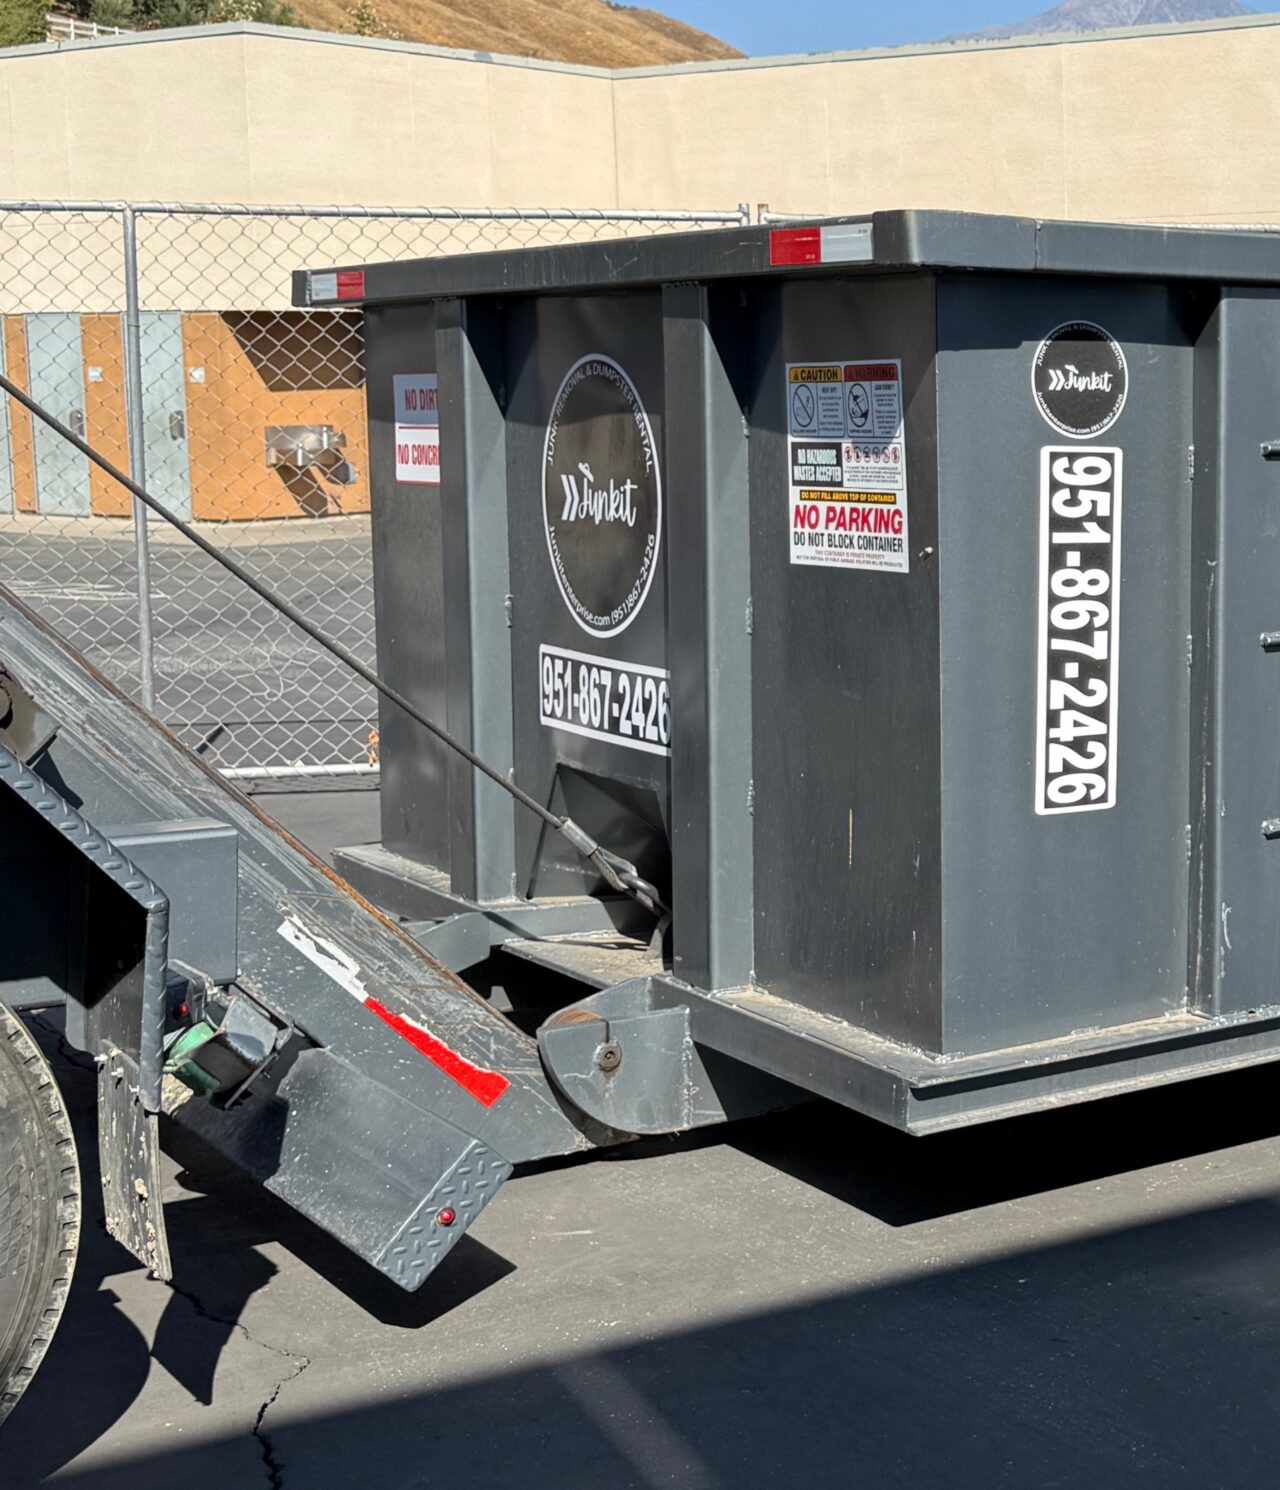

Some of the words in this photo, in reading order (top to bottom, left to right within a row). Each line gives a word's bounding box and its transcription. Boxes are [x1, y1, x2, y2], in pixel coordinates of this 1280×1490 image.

[800, 368, 838, 381] CAUTION
[1064, 364, 1113, 392] Junkit
[404, 388, 417, 411] NO
[547, 420, 559, 467] JUNK
[556, 368, 586, 417] REMOVAL
[592, 362, 635, 405] DUMPSTER
[632, 402, 653, 473] RENTAL
[398, 443, 409, 465] NO
[578, 462, 638, 527] Junkit
[794, 504, 820, 530] NO
[824, 506, 903, 535] PARKING
[794, 531, 806, 546] DO
[808, 532, 825, 548] NOT
[827, 533, 855, 549] BLOCK
[857, 535, 903, 553] CONTAINER
[549, 525, 611, 626] Junkitenterprise.com
[611, 533, 655, 625] (951)867-2426
[1047, 455, 1112, 804] 951-867-2426
[543, 655, 670, 745] 951-867-2426
